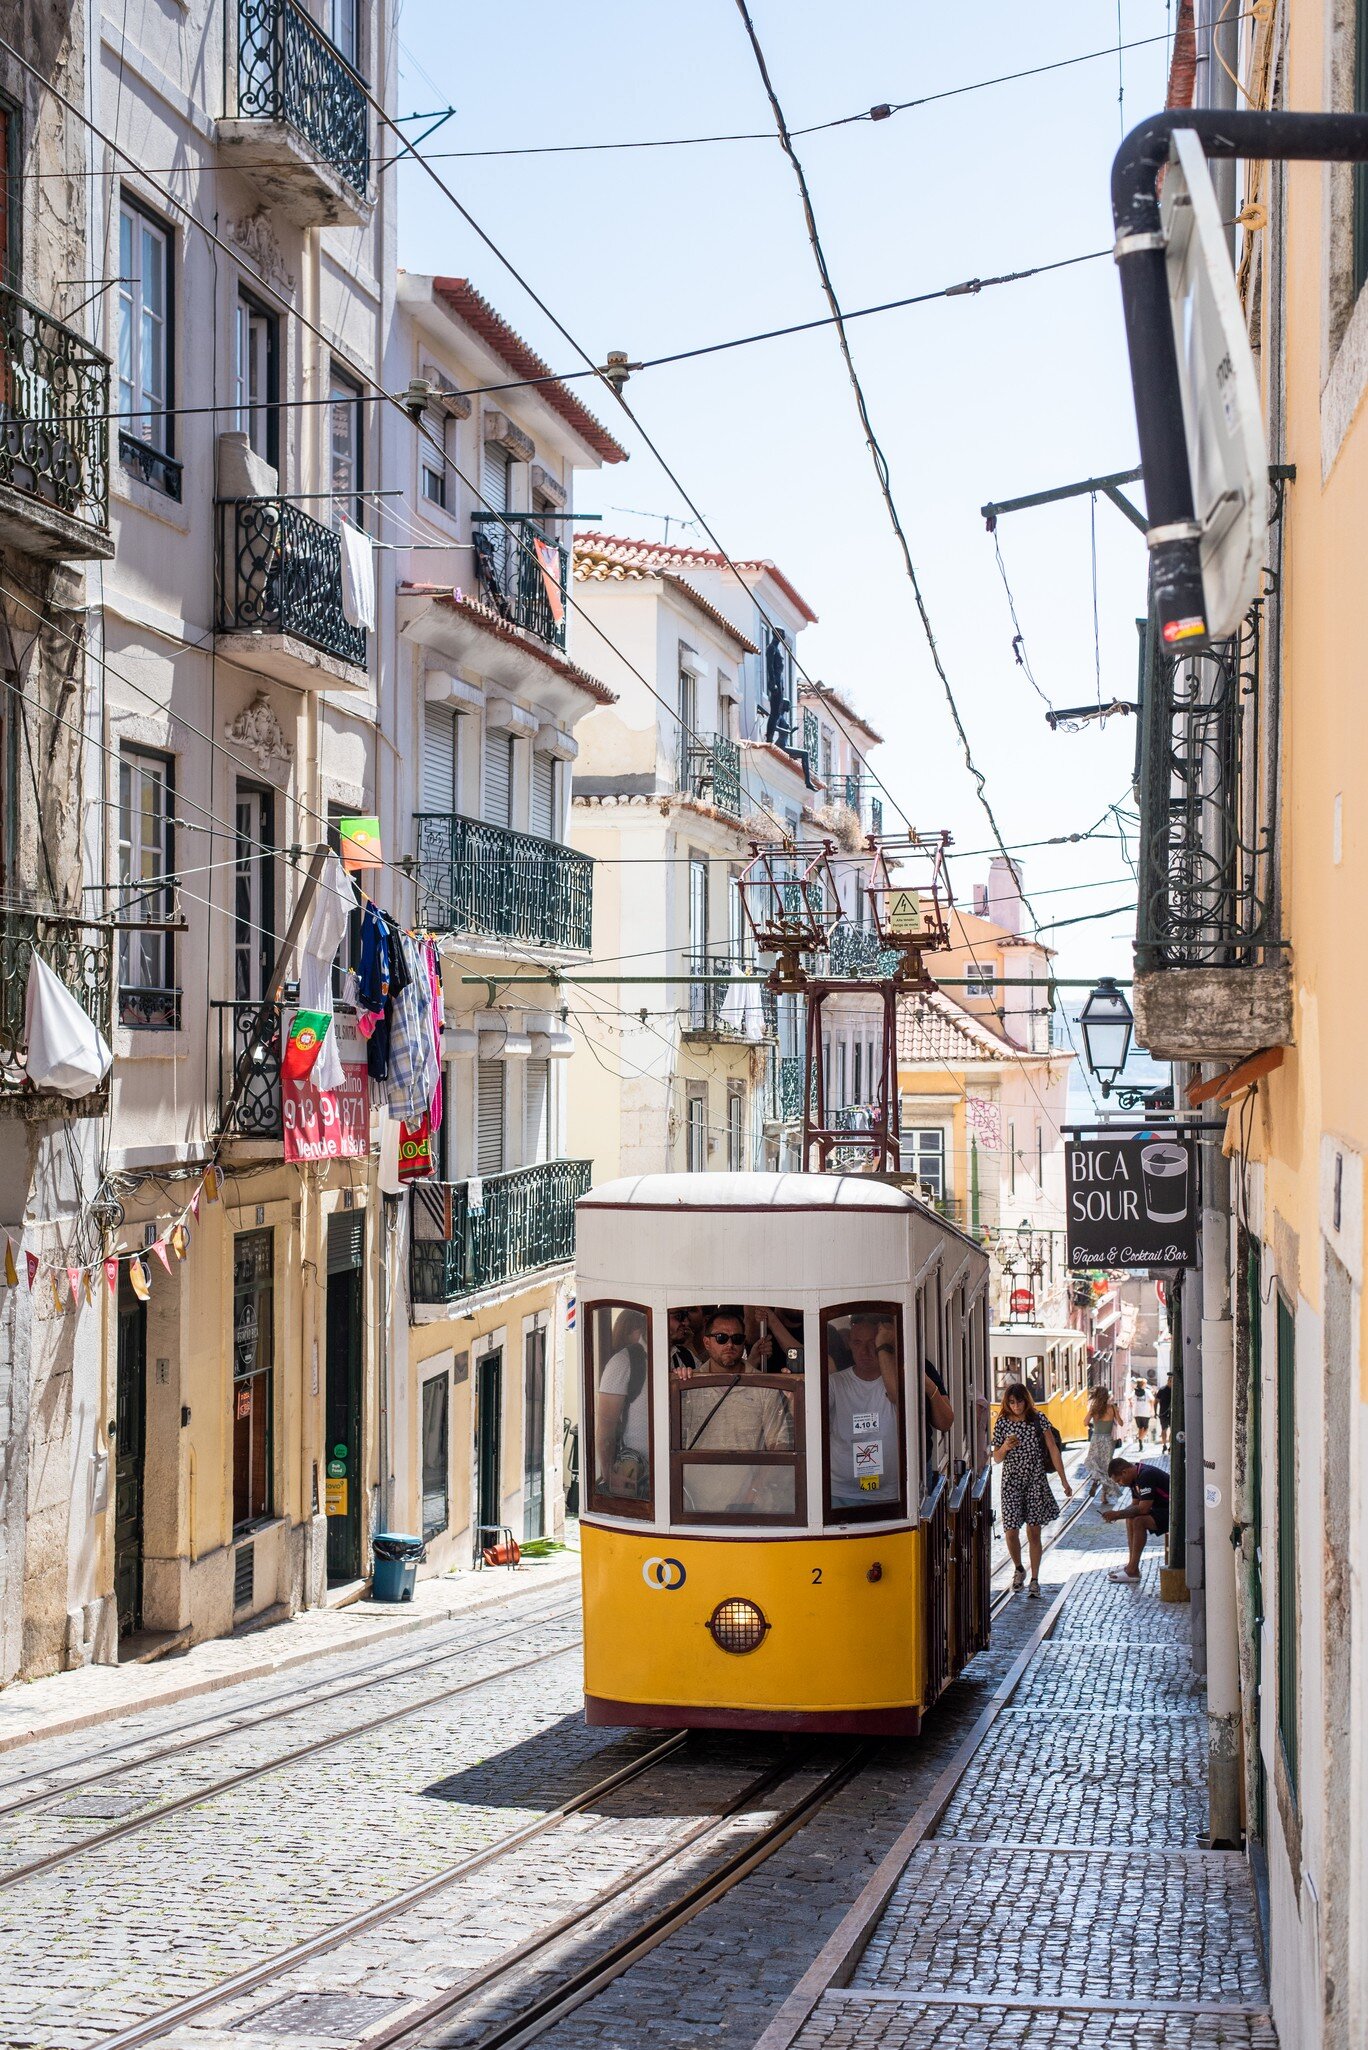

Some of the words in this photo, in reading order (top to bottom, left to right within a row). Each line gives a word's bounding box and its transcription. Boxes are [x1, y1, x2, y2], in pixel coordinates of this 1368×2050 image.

[343, 1097, 365, 1126] 871
[1071, 1150, 1130, 1182] BICA
[1072, 1190, 1140, 1222] SOUR
[1072, 1246, 1106, 1266] Tapas
[1106, 1246, 1118, 1264] &
[1120, 1246, 1163, 1263] Cocktail
[1163, 1244, 1188, 1261] Bar
[854, 1421, 871, 1429] 4.10
[872, 1420, 878, 1428] €
[860, 1481, 877, 1491] 4.10
[811, 1568, 823, 1585] 2
